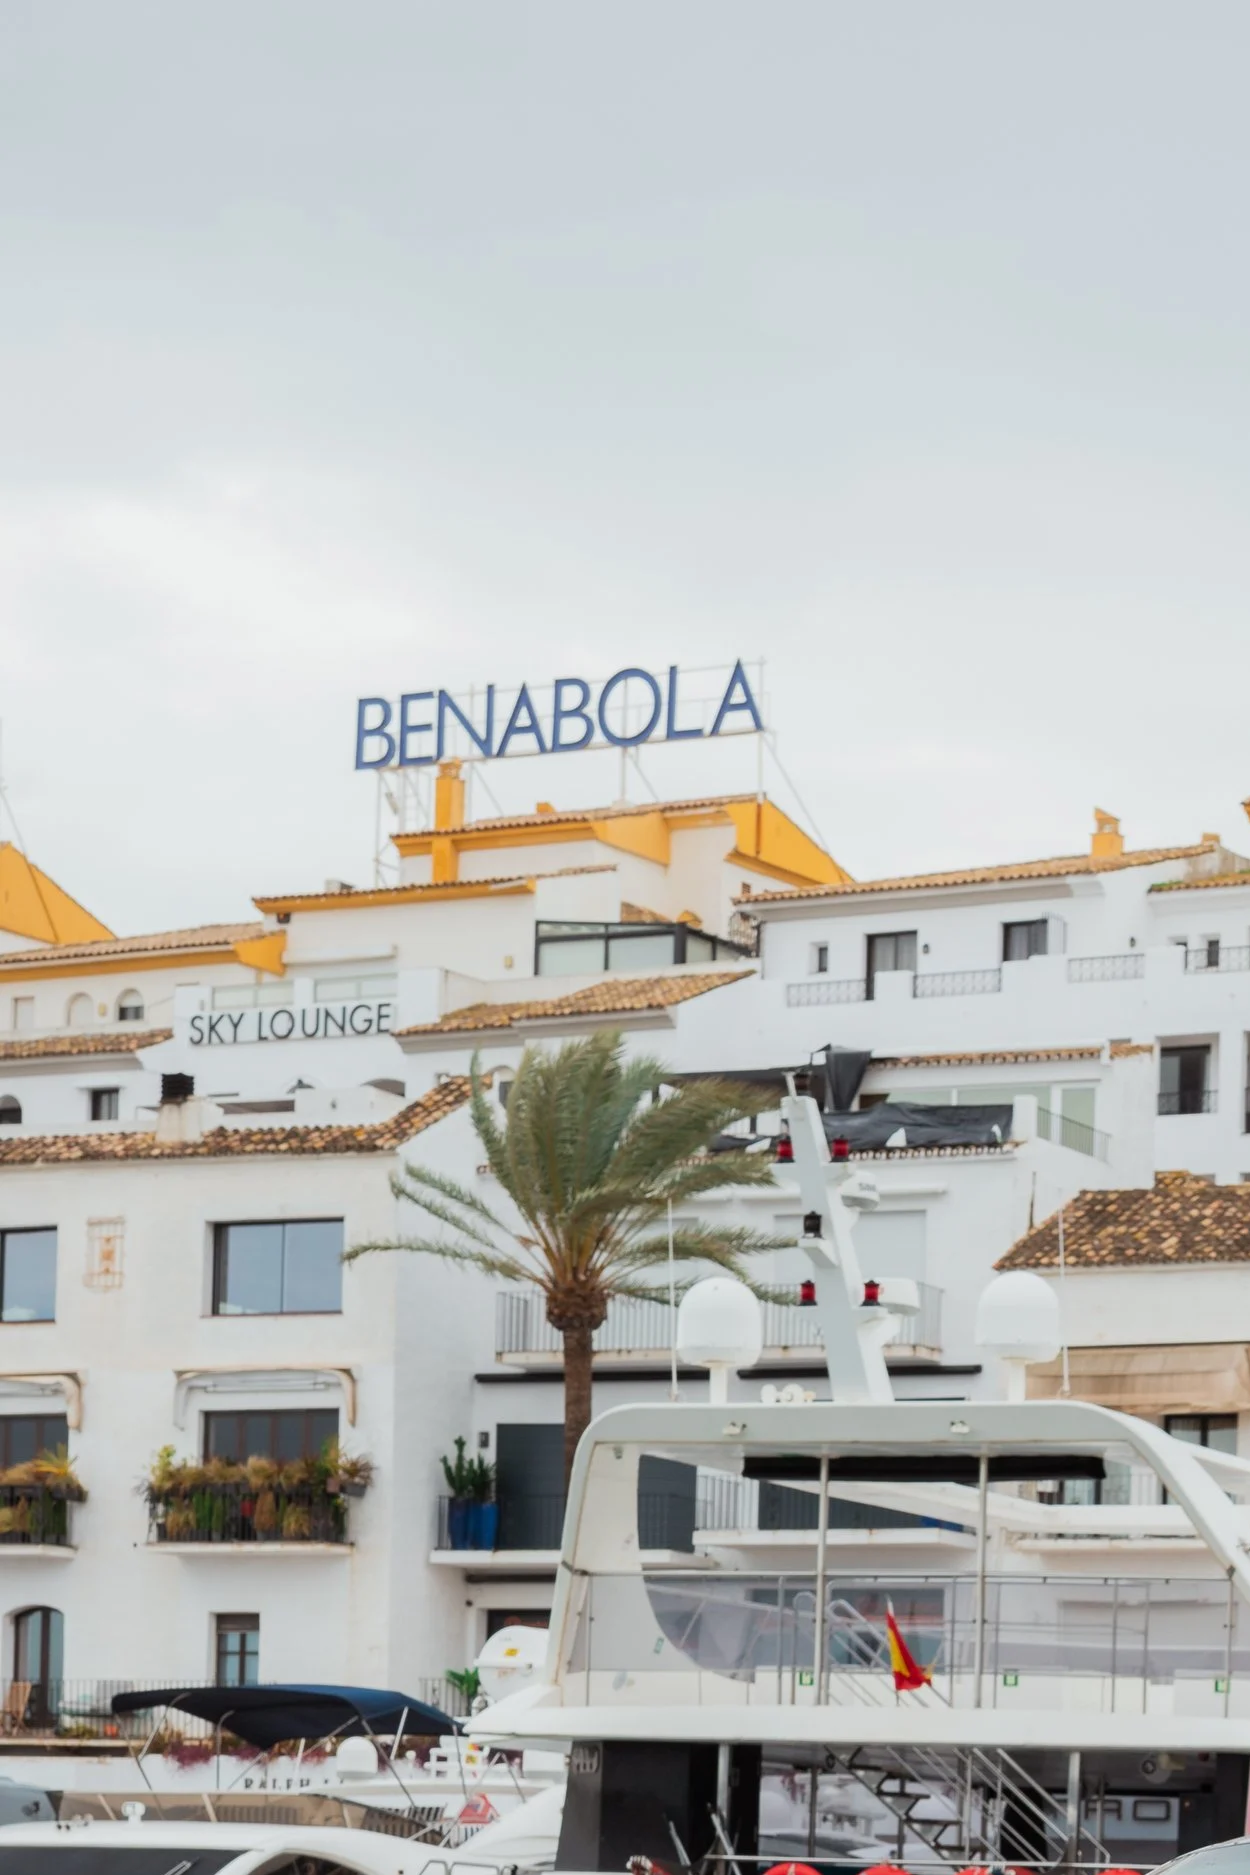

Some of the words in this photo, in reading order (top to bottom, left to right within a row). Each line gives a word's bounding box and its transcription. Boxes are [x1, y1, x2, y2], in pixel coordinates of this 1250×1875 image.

[355, 657, 764, 770] BENABOLA
[189, 1012, 244, 1045] SKY
[258, 1003, 391, 1041] LOUNGE
